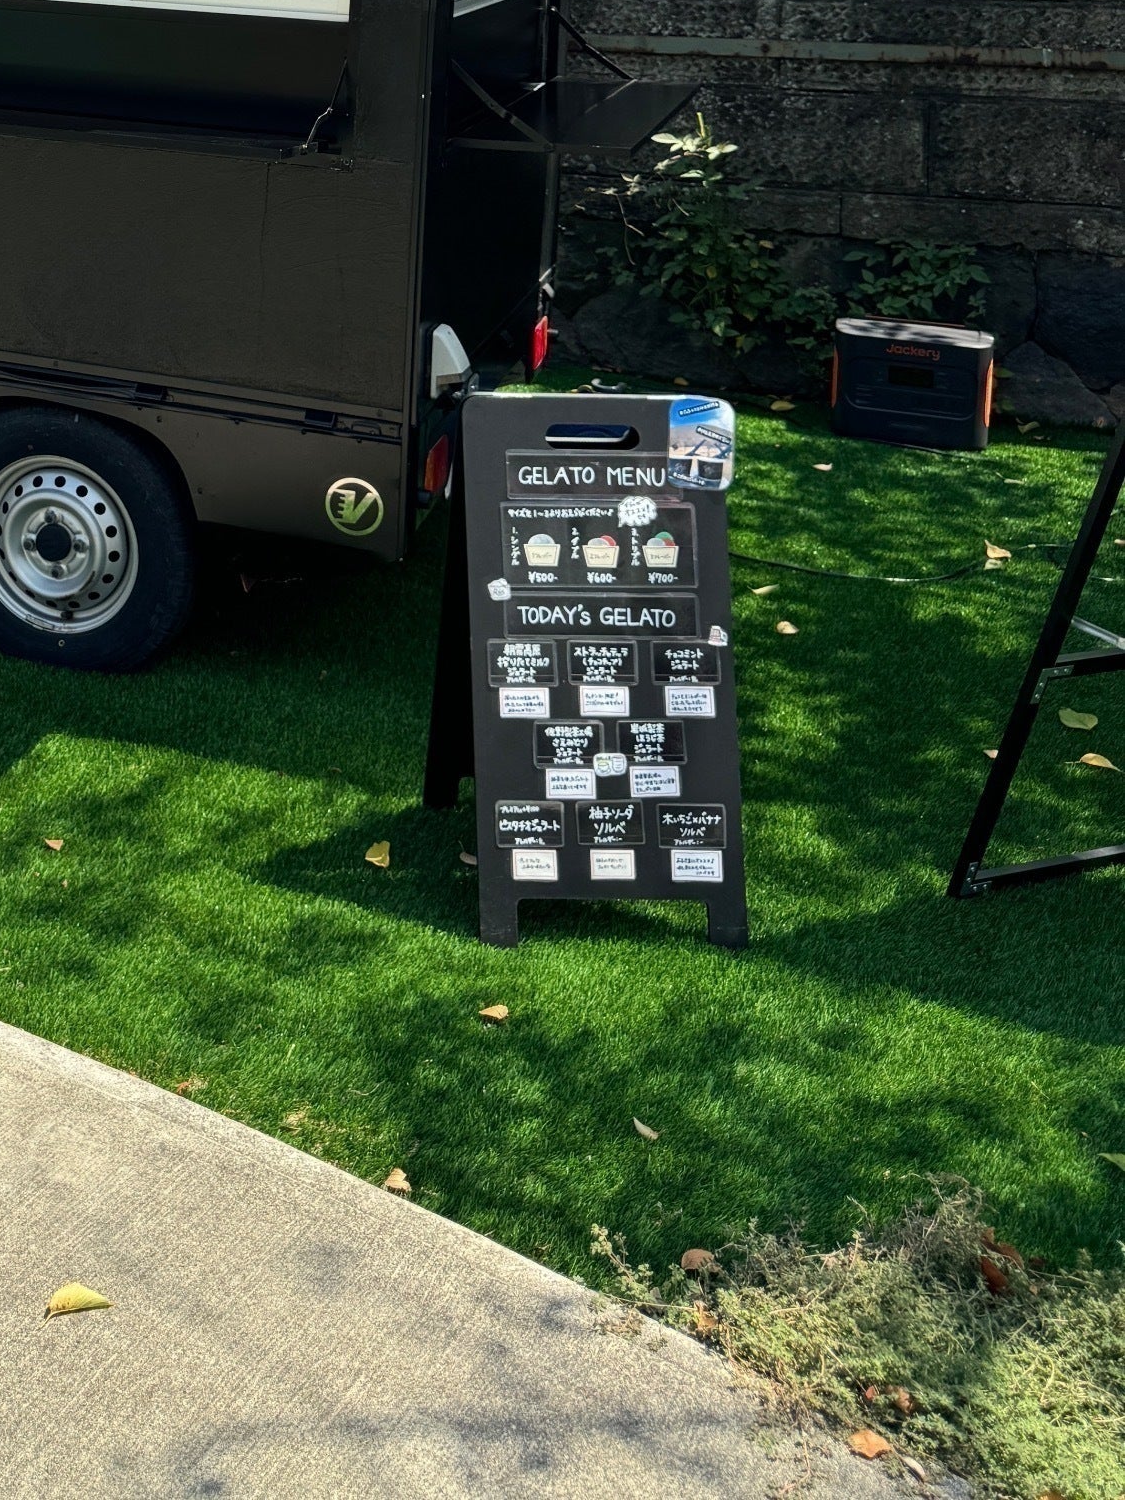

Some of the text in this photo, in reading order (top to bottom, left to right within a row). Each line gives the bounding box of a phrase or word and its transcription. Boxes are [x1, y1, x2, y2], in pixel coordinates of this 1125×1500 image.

[885, 343, 941, 361] Jackery
[518, 466, 596, 486] GELATO
[606, 466, 666, 487] MENU
[517, 604, 676, 628] TODAY's GELATO
[664, 647, 704, 659] チョコミント
[586, 666, 617, 675] ジェラート
[670, 660, 700, 670] ジェラート
[507, 667, 537, 676] ジェラート
[555, 747, 583, 757] ジェラート
[633, 743, 664, 754] ジェラート
[588, 804, 635, 820] 柚子ソーダ
[593, 820, 626, 836] ソルベ
[679, 826, 707, 837] ソルベ
